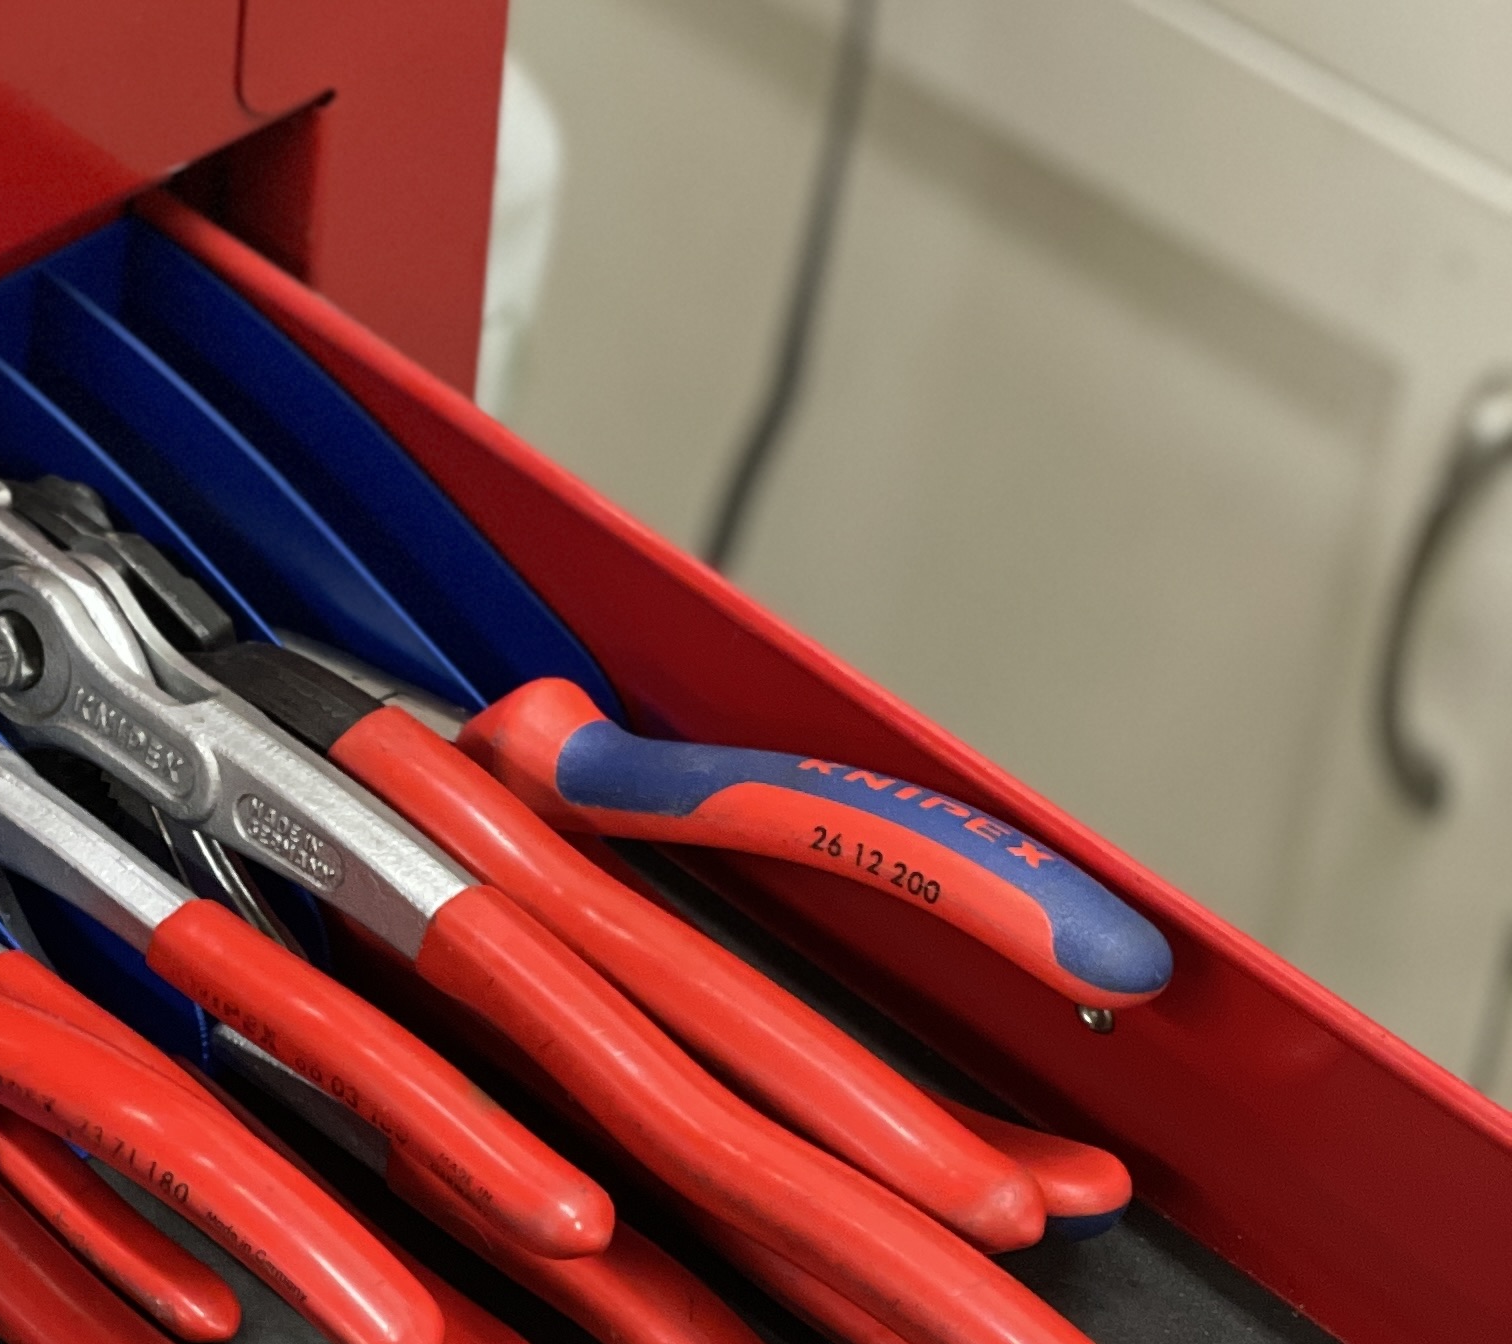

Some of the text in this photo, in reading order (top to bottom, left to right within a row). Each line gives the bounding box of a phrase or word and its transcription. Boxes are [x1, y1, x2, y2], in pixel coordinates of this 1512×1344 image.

[797, 758, 1056, 869] KNIPEX
[810, 825, 941, 905] 26 12 200
[149, 1159, 188, 1204] 180
